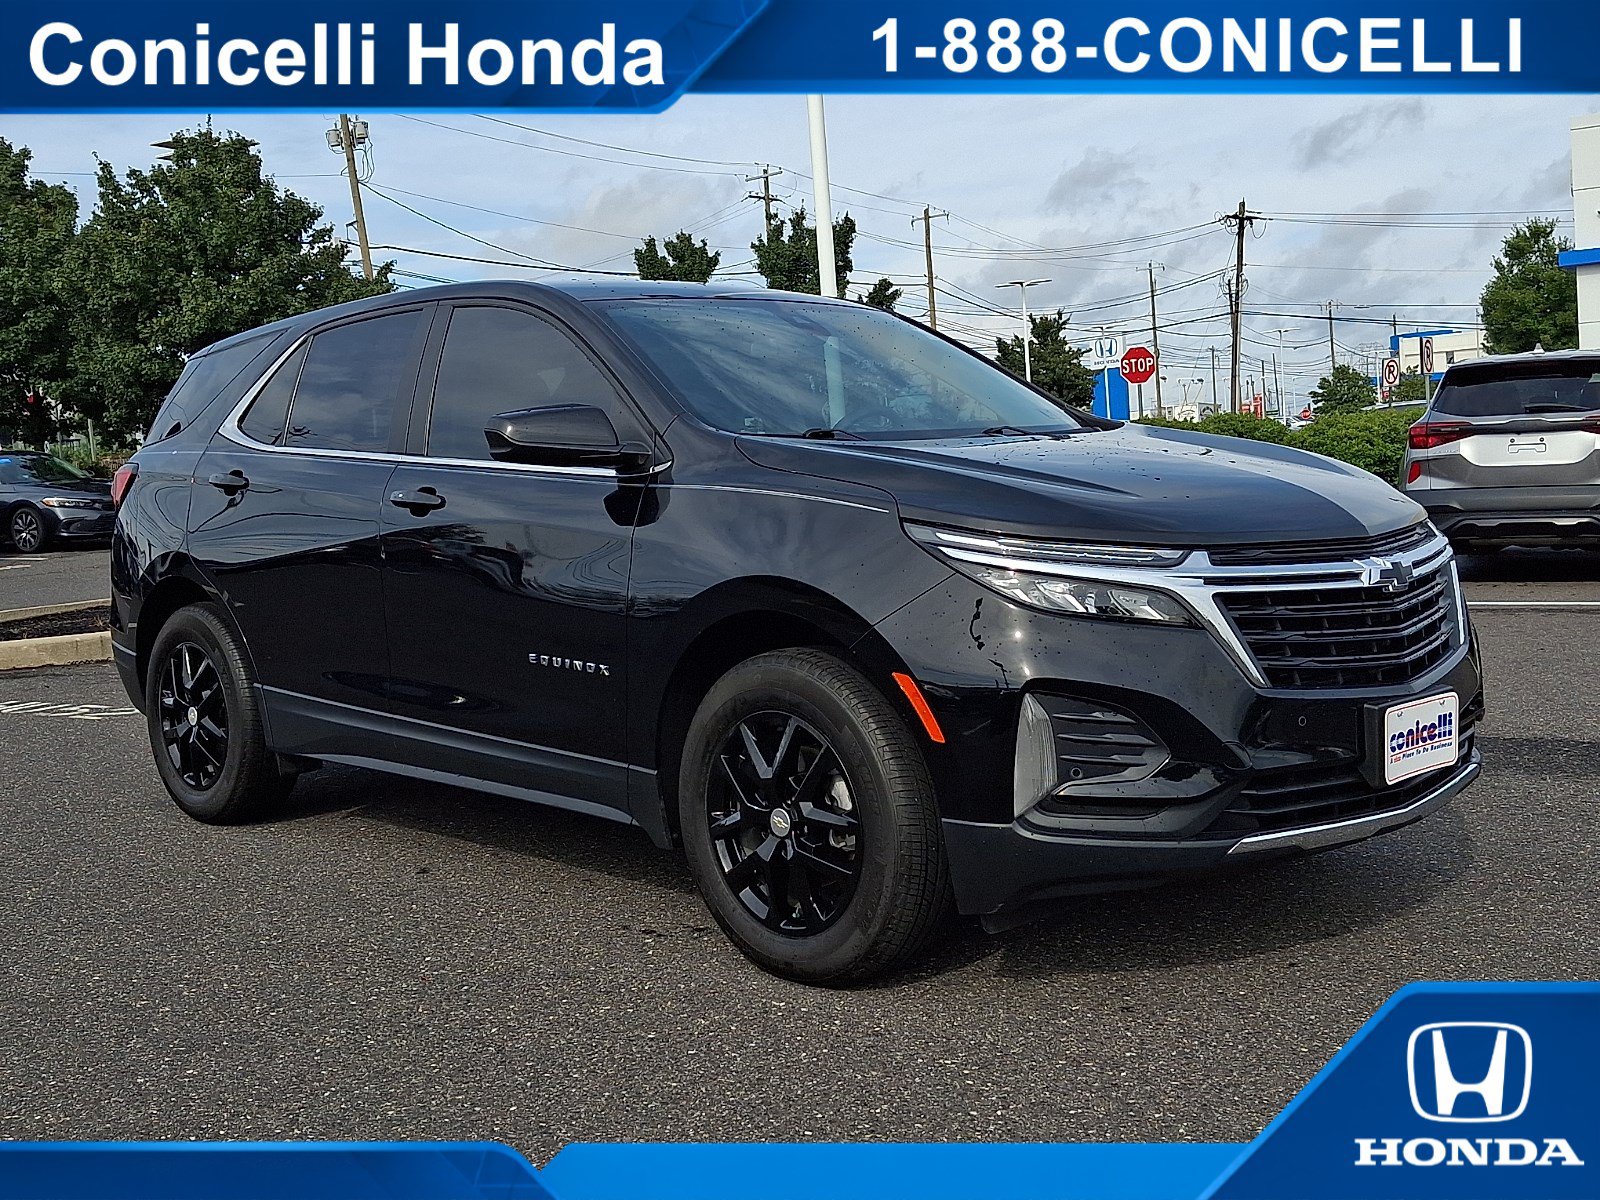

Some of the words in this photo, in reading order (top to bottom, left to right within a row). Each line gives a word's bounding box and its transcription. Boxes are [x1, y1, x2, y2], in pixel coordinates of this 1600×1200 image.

[1122, 358, 1154, 373] STOP
[529, 653, 610, 676] EQUINOX
[1390, 712, 1452, 752] conicelli
